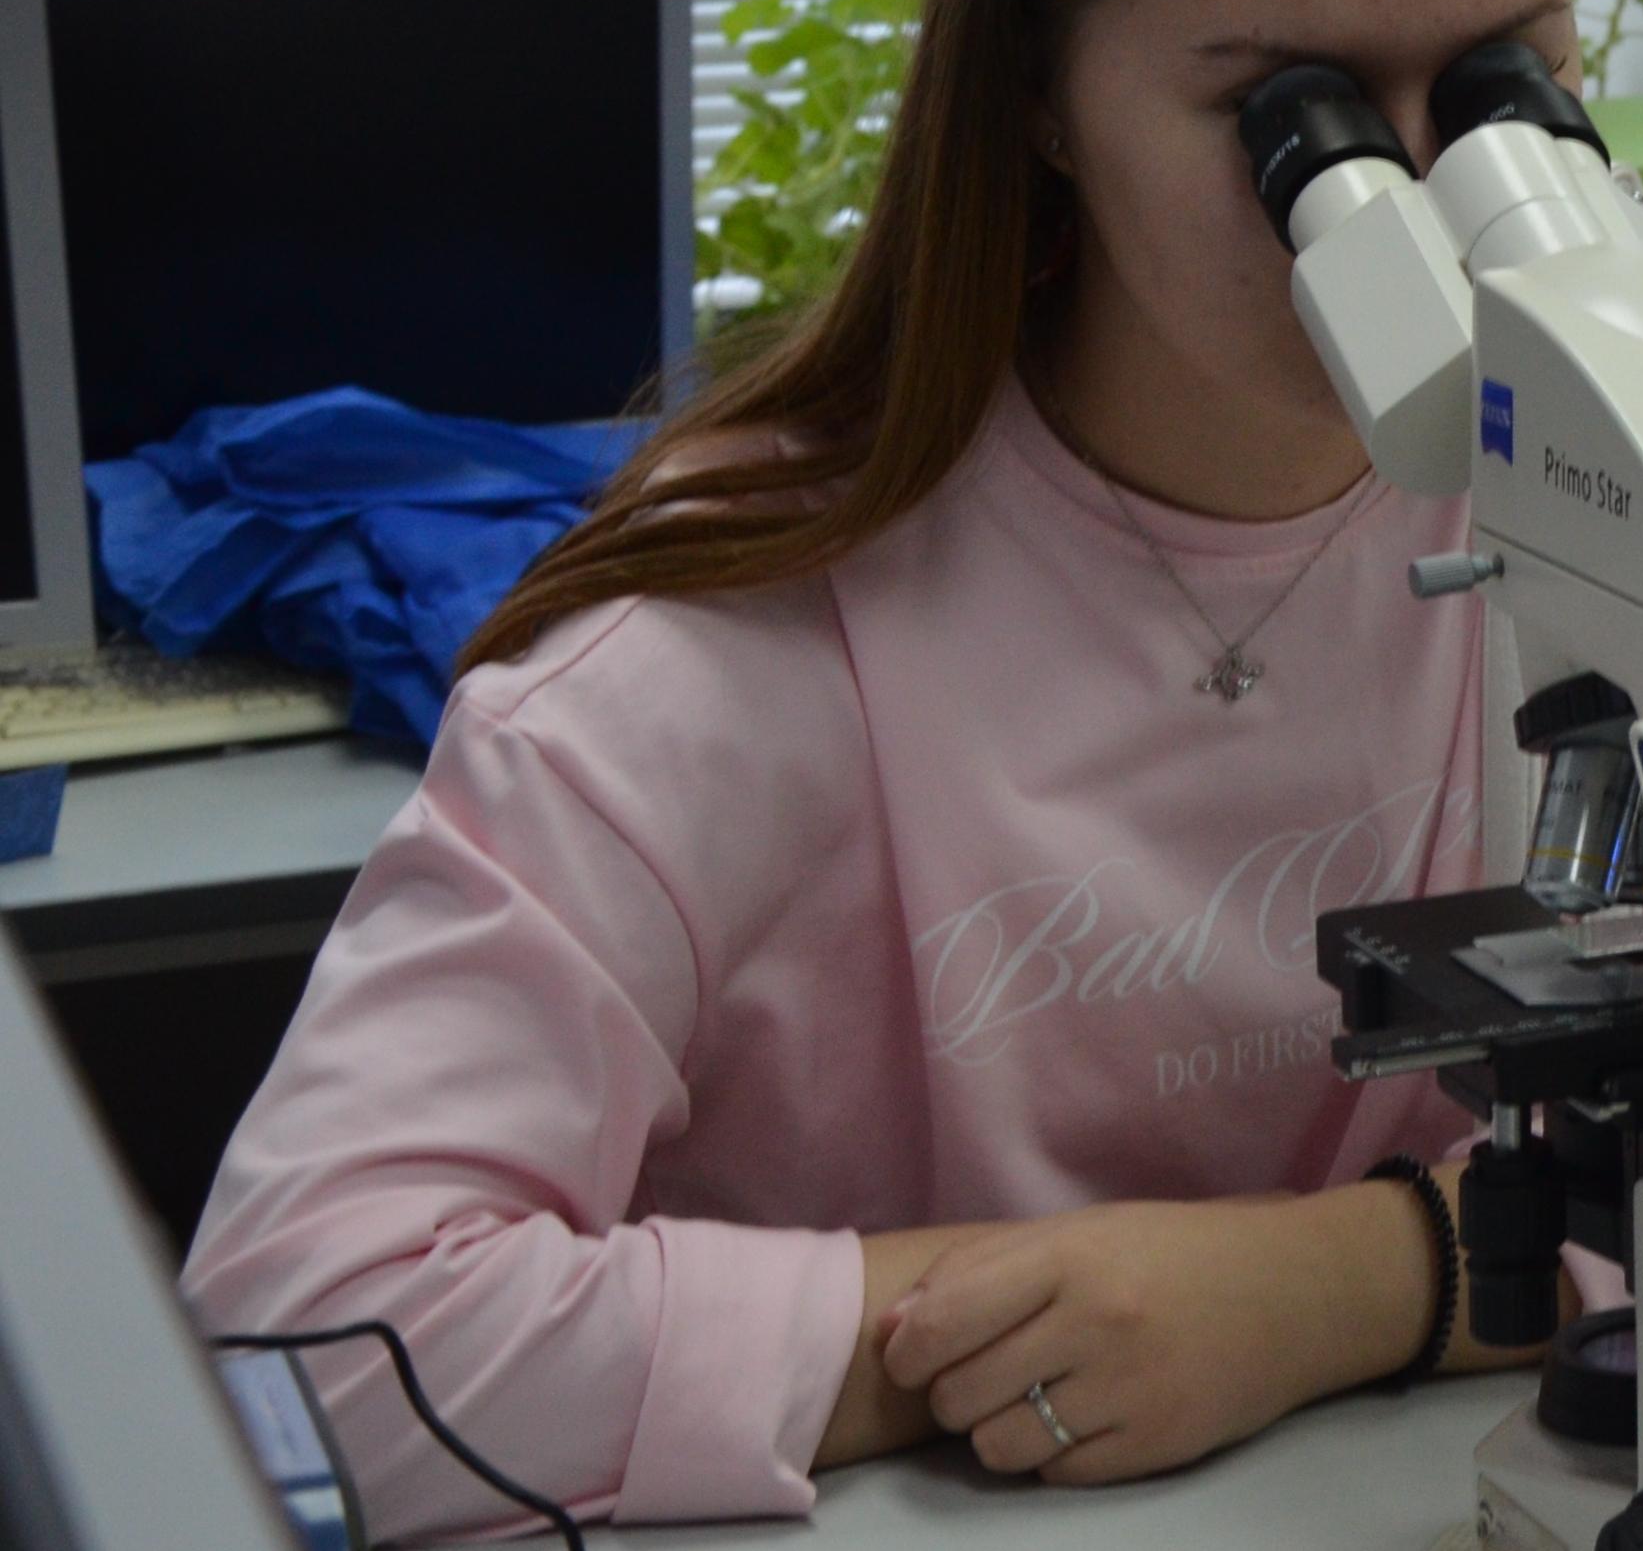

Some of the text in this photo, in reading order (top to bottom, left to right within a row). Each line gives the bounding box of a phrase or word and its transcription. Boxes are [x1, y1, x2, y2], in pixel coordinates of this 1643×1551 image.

[1544, 446, 1632, 521] Primo Star
[911, 829, 1318, 1066] Bad
[1156, 1043, 1218, 1096] DO
